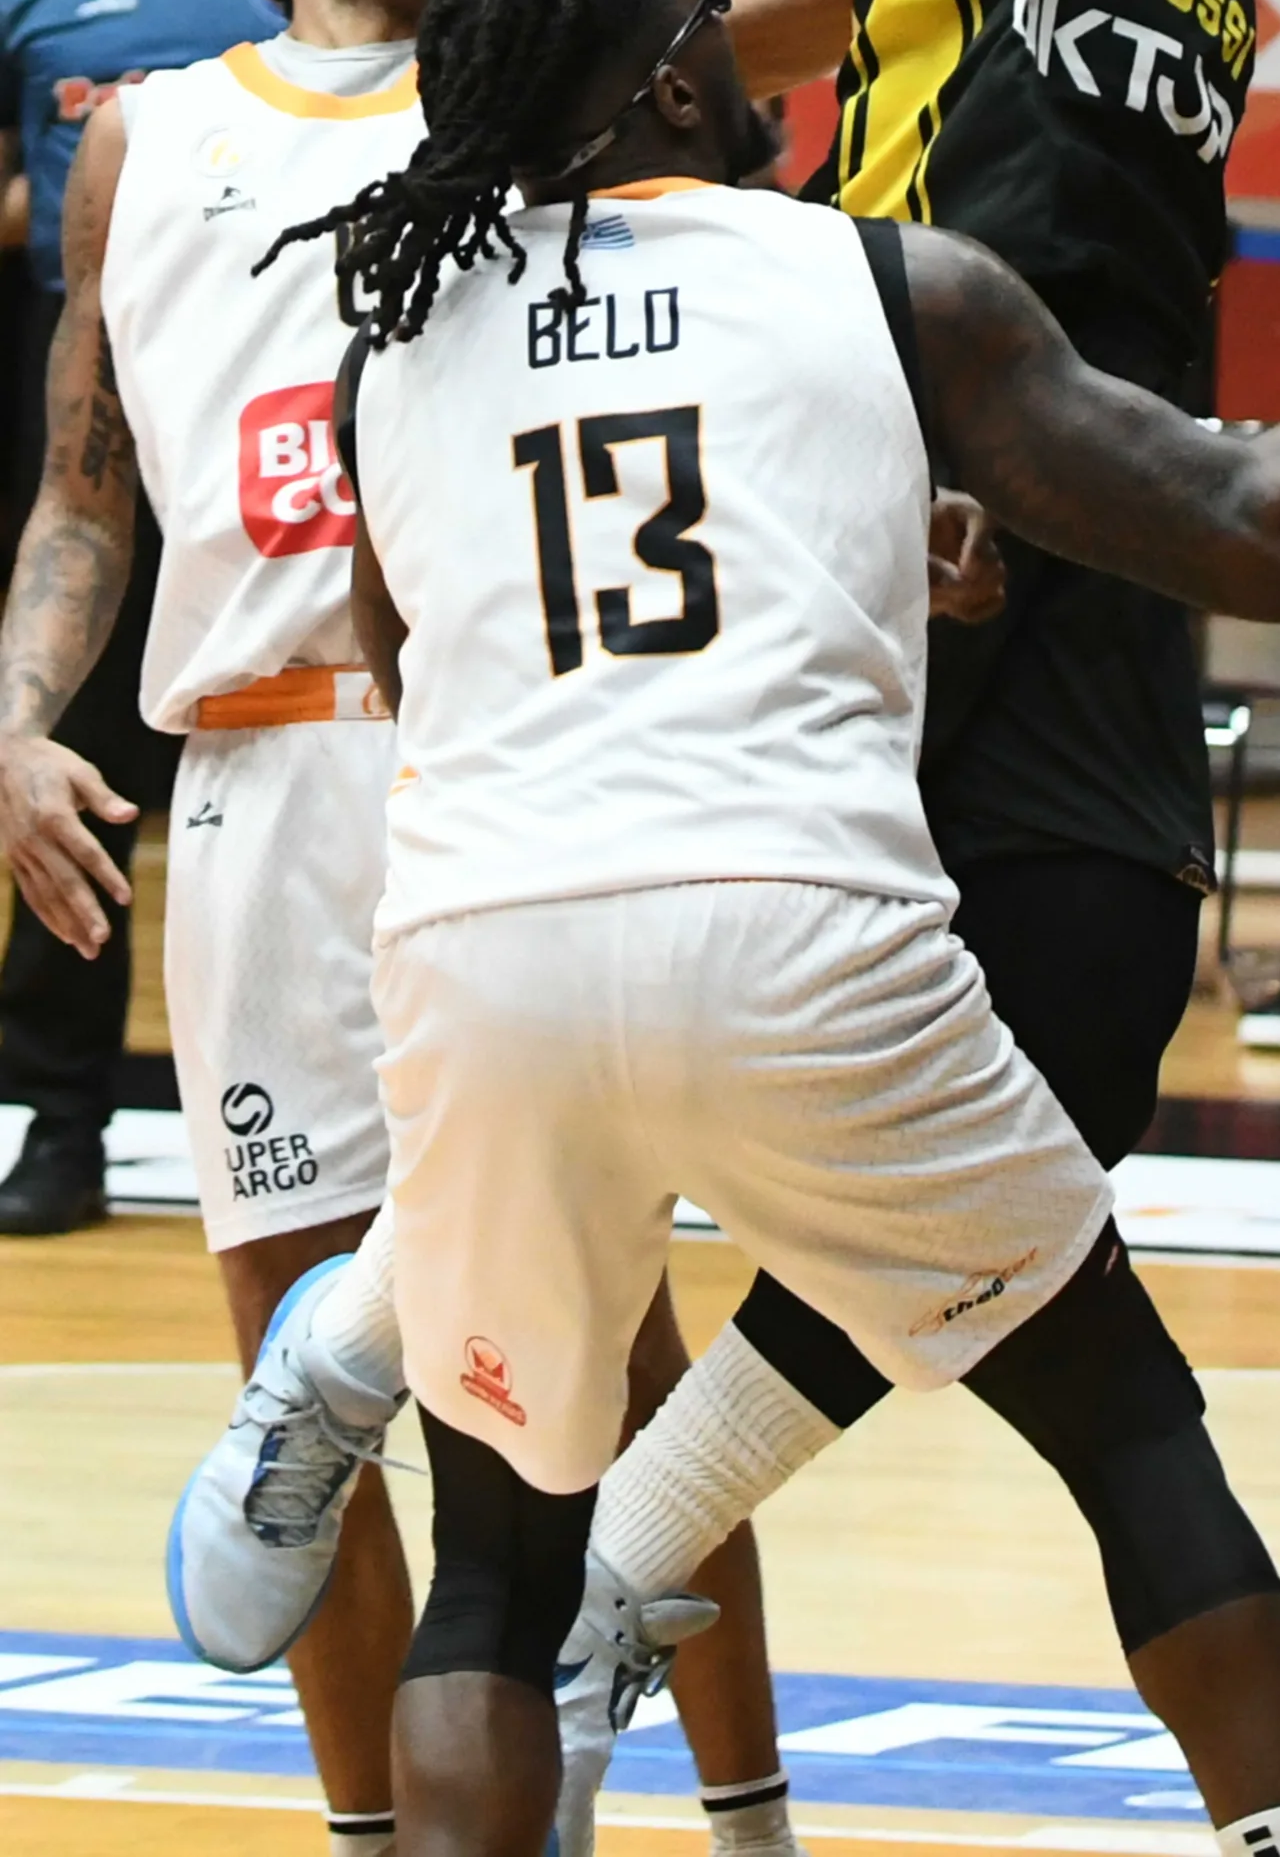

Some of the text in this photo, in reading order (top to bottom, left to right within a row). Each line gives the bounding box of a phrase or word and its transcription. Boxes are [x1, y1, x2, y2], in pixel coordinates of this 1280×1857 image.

[527, 286, 680, 370] BELO
[271, 462, 357, 524] CO
[511, 404, 722, 680] 13
[224, 1133, 313, 1172] UPER
[232, 1159, 319, 1202] ARGO
